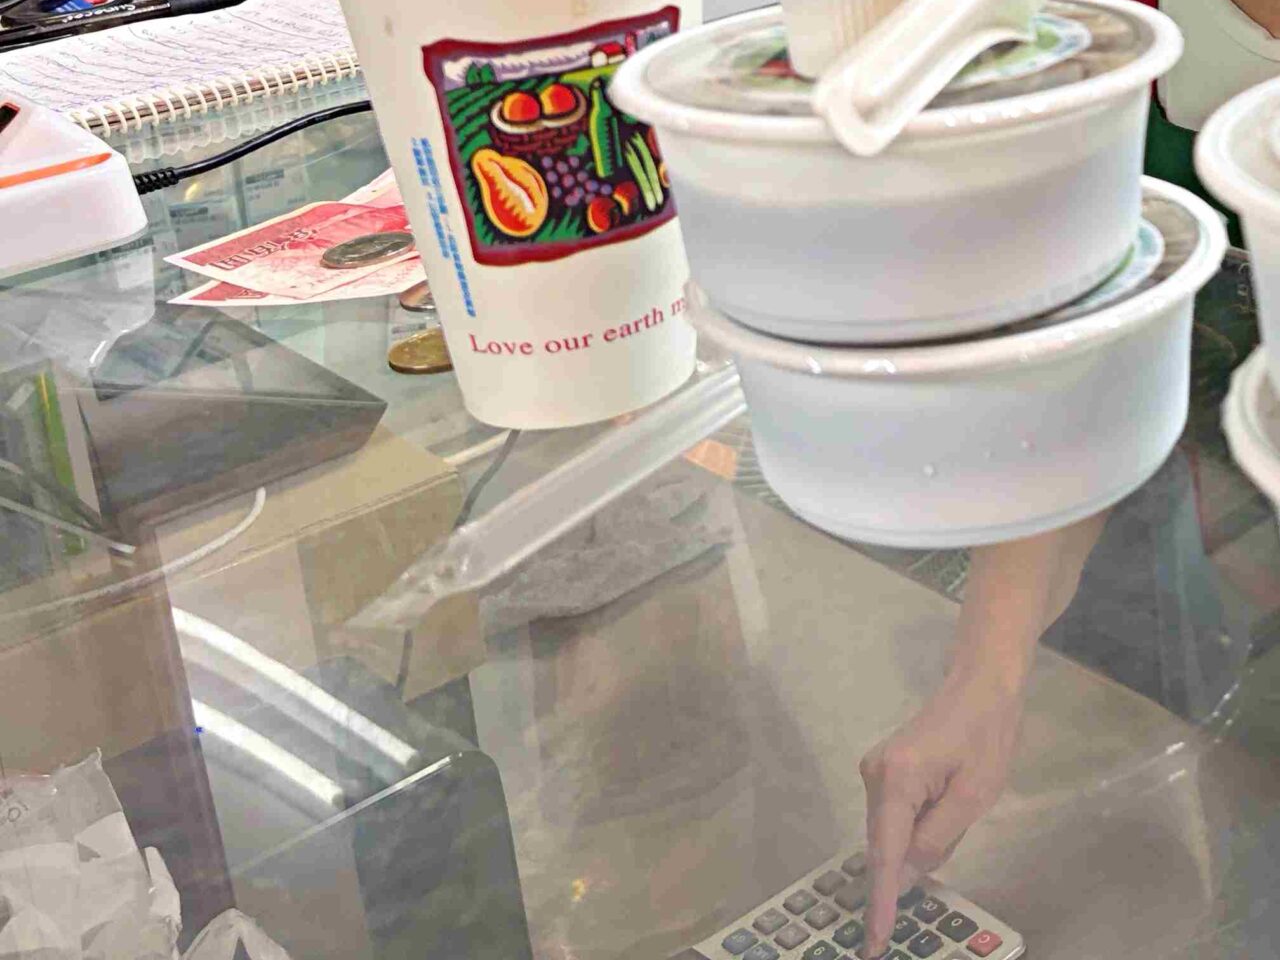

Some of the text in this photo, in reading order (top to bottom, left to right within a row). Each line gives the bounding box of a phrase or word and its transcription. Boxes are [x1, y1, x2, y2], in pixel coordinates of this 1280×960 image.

[468, 333, 535, 356] Love
[544, 333, 594, 354] our
[602, 307, 665, 343] earth
